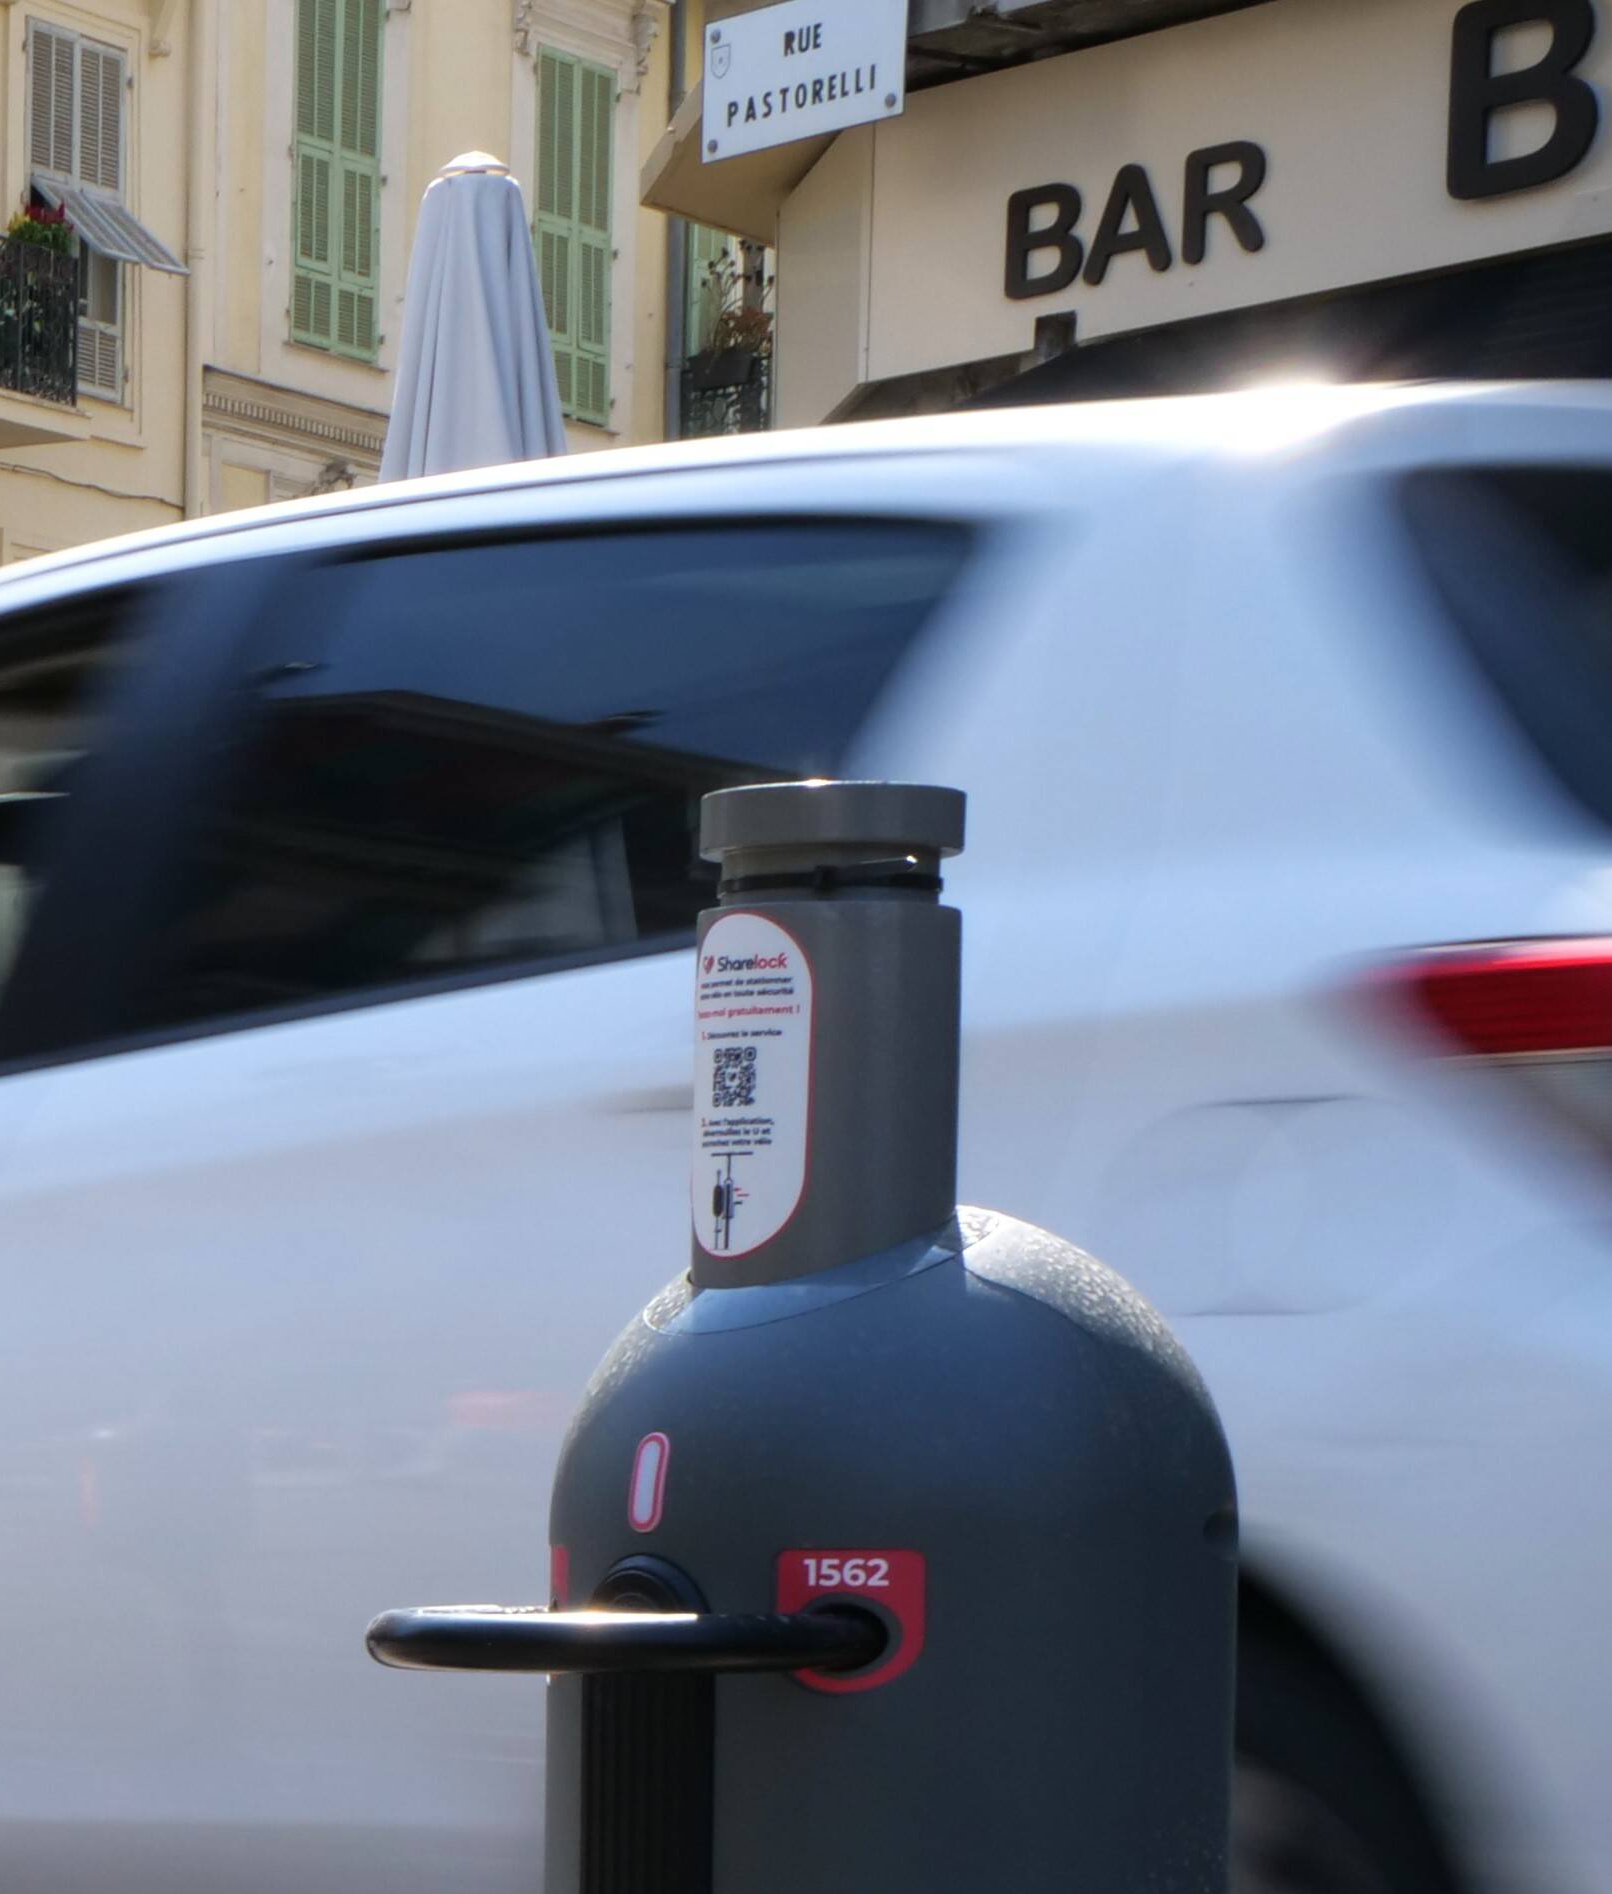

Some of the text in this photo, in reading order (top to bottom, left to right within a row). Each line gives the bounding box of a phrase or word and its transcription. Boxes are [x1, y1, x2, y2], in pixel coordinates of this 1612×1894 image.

[783, 22, 823, 57] RUE
[726, 63, 877, 128] PASTORELLI
[1004, 139, 1267, 301] BAR
[717, 952, 788, 973] Sharelock
[803, 1558, 890, 1587] 1562
